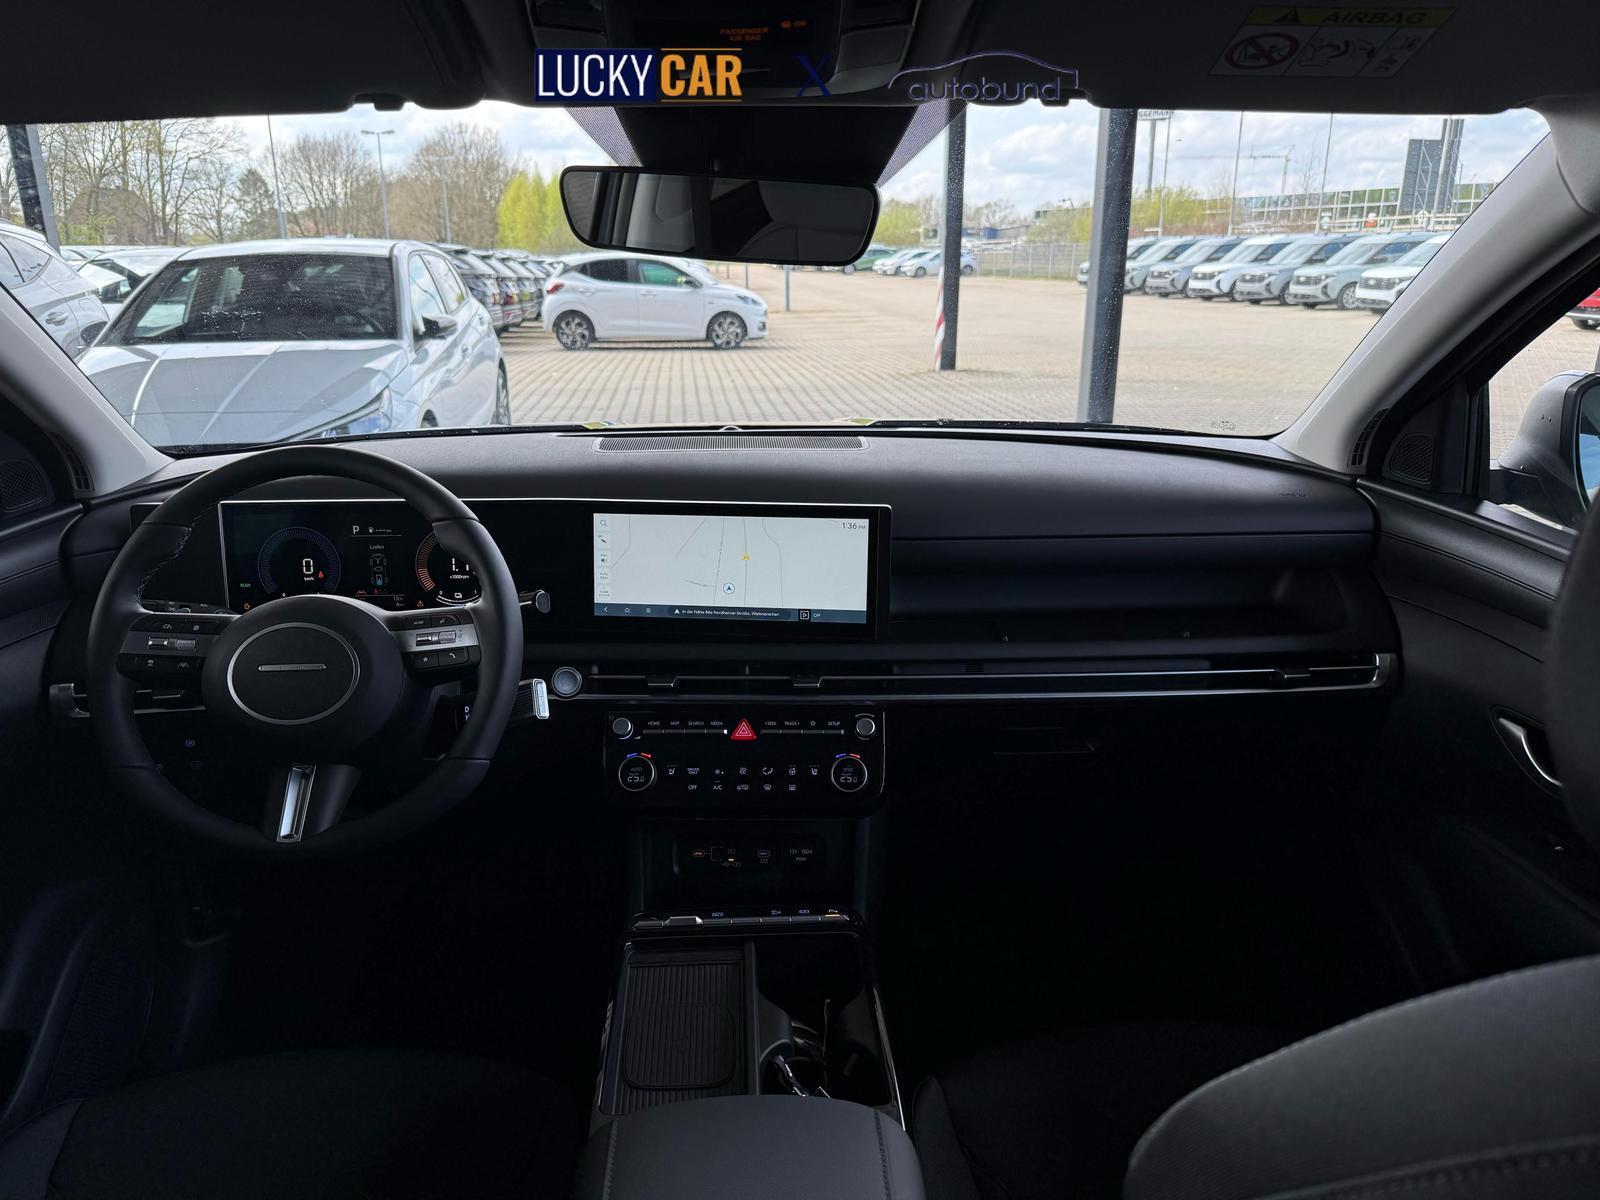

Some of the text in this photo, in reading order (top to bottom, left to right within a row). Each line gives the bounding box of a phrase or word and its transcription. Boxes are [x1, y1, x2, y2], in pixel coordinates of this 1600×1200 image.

[1322, 11, 1427, 24] AIRBAG
[352, 525, 360, 535] P
[302, 558, 314, 575] 0
